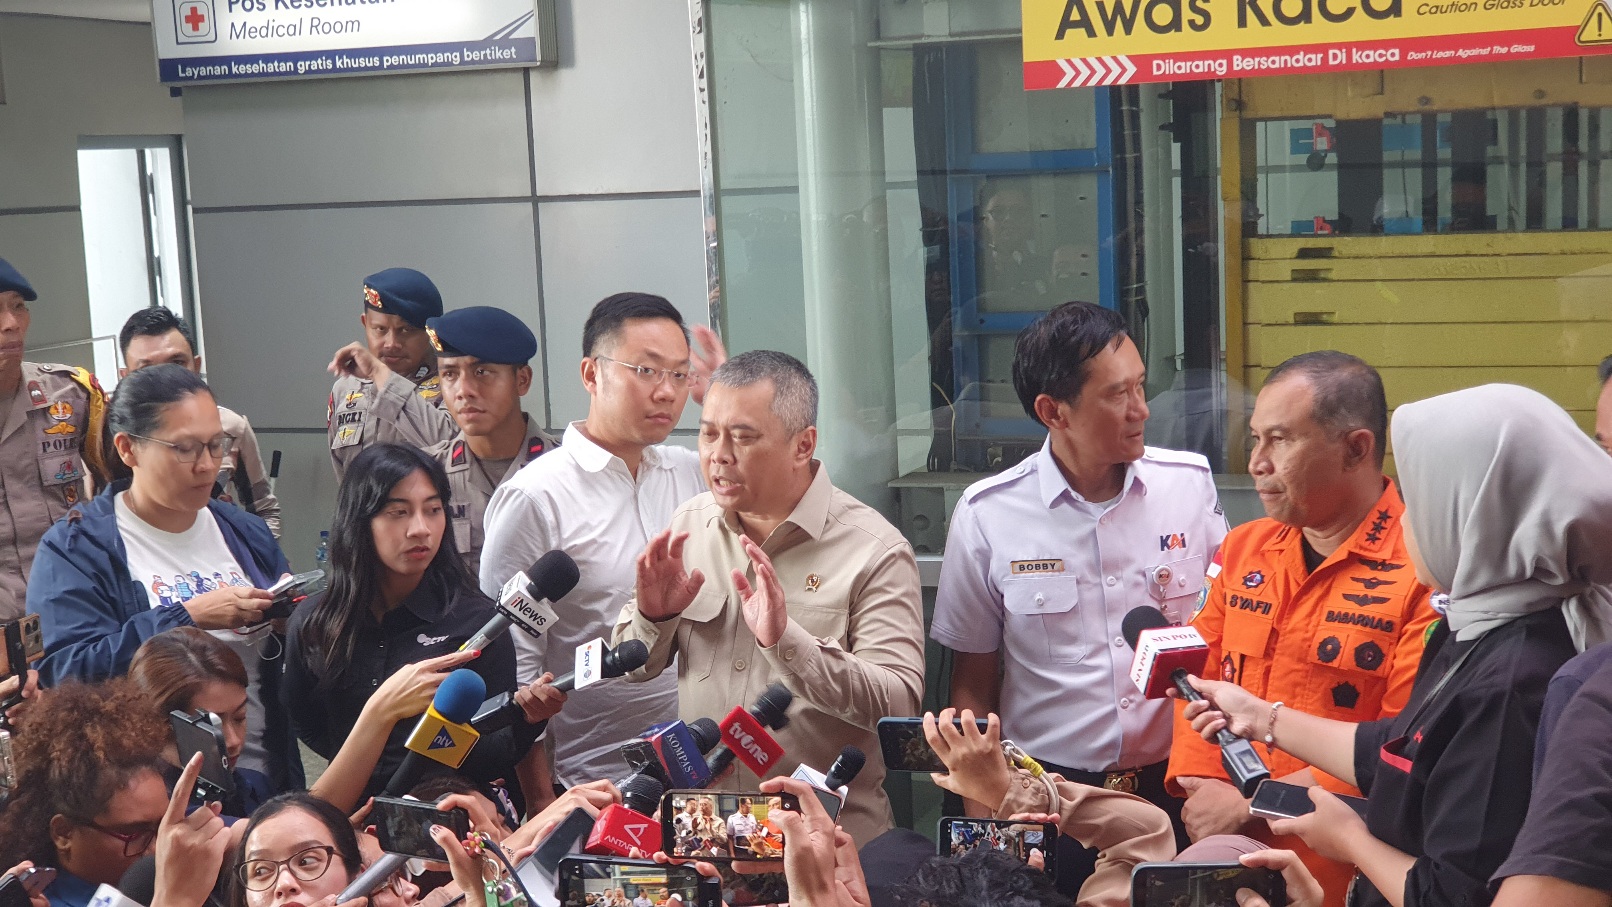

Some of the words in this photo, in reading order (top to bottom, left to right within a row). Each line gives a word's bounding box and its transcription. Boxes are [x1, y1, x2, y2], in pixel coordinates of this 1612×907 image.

[228, 0, 266, 13] Pos
[1416, 0, 1478, 16] Caution
[1483, 0, 1524, 11] Glass
[229, 17, 302, 40] Medical
[310, 16, 361, 35] Room
[1054, 0, 1212, 41] Awas
[178, 64, 228, 79] Layanan
[231, 60, 294, 75] kesehatan
[297, 56, 333, 74] gratis
[336, 54, 379, 69] khusus
[383, 51, 460, 69] penumpang
[463, 46, 517, 62] bertiket
[1152, 58, 1227, 76] Dilarang
[1232, 51, 1323, 71] Bersandar
[1328, 48, 1346, 66] Di
[1352, 48, 1400, 64] kaca
[1407, 51, 1431, 60] Don't
[1432, 50, 1455, 59] Lean
[1456, 47, 1491, 58] Against
[1492, 45, 1508, 55] The
[1510, 44, 1536, 54] Glass
[1160, 533, 1187, 551] KAI
[1019, 562, 1056, 572] BOBBY
[511, 597, 546, 626] iNews
[1230, 594, 1272, 615] SYAFII
[1325, 610, 1394, 633] BASARNAS
[667, 733, 693, 773] KOMPAS
[729, 721, 769, 766] tvOne
[603, 835, 634, 851] ANTAR
